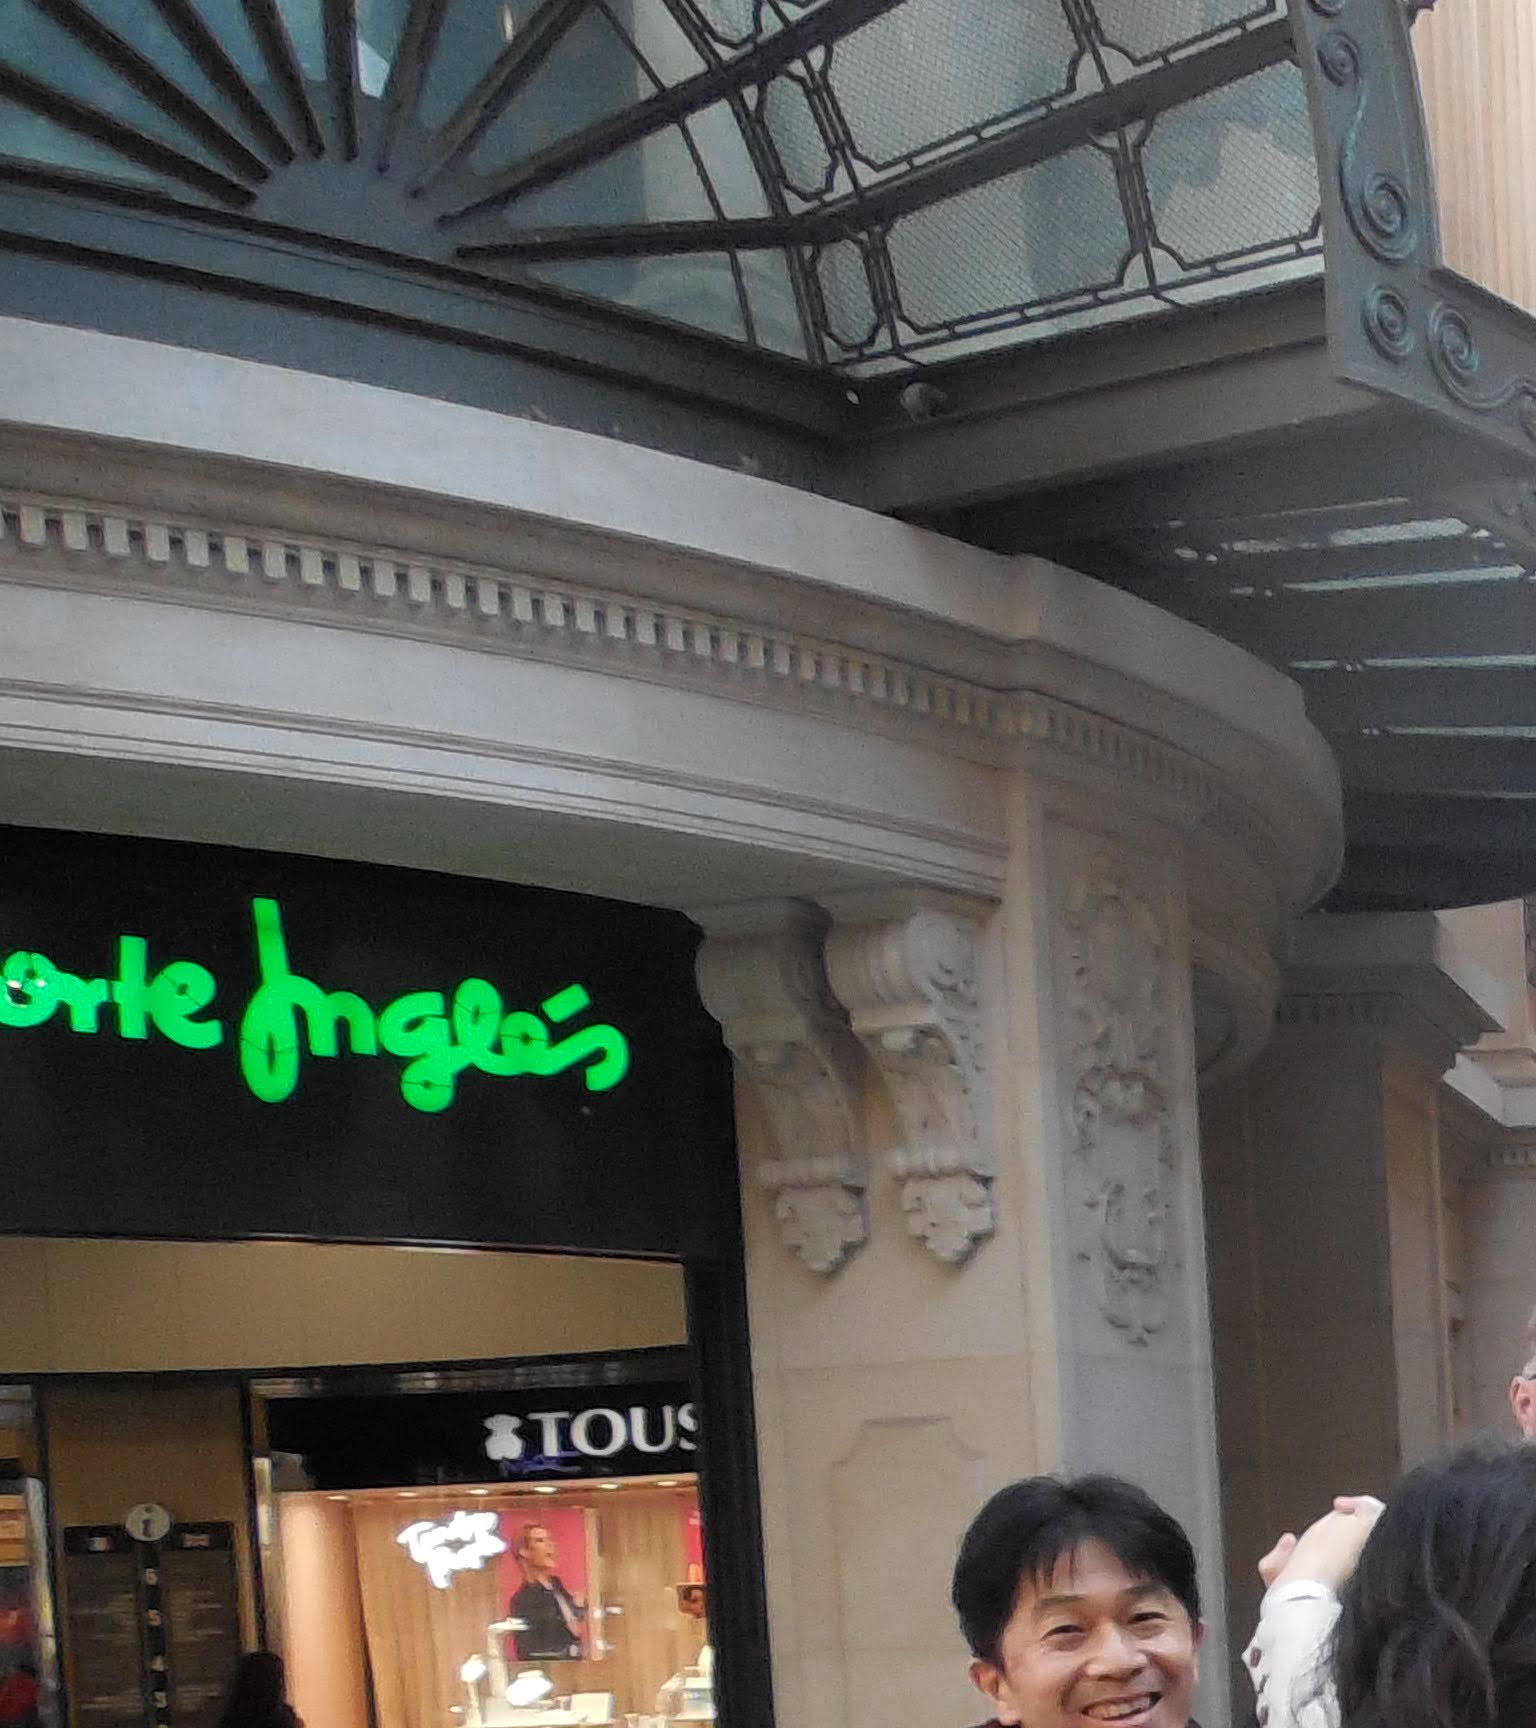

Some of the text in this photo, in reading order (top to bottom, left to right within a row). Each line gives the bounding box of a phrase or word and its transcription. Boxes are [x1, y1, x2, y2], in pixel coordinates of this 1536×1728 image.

[0, 897, 629, 1113] orte Inglés
[526, 1403, 698, 1457] TOUS
